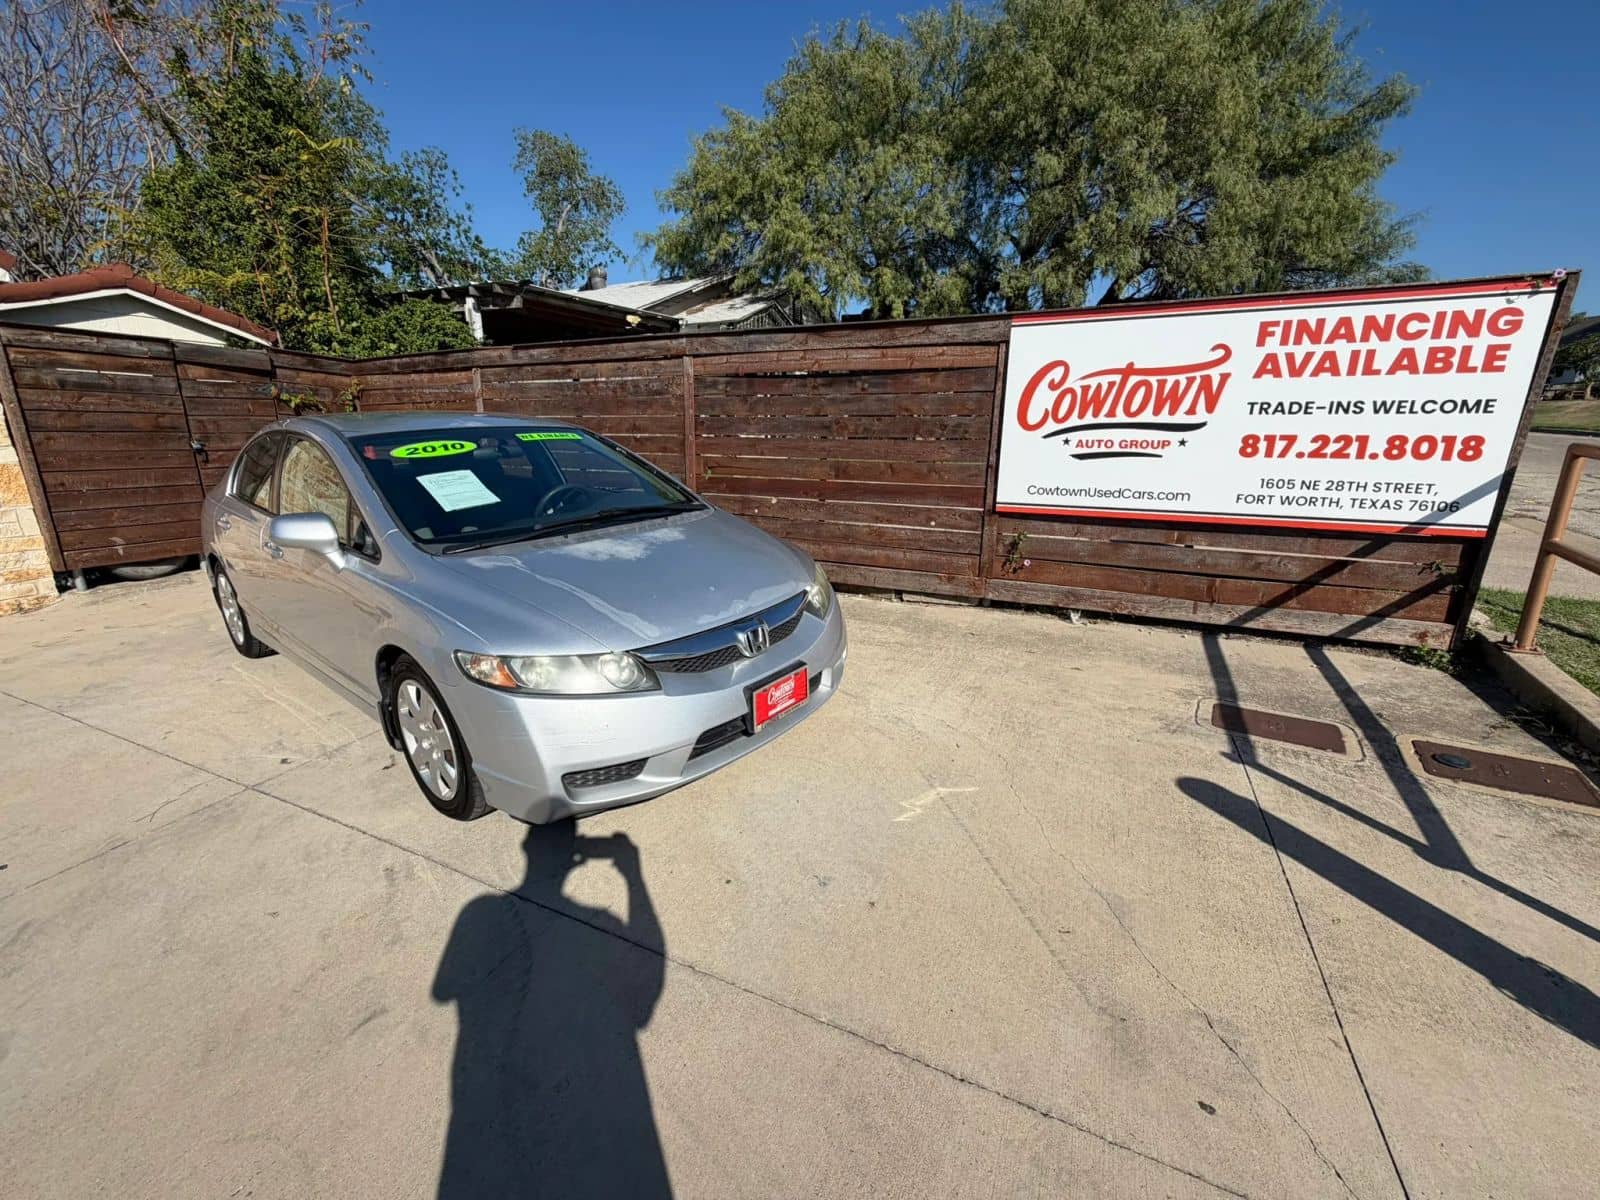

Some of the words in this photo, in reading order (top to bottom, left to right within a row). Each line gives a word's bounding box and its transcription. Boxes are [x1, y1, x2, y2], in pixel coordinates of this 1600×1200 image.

[1256, 307, 1525, 347] FINANCING
[1252, 344, 1512, 379] AVAILABLE
[1247, 400, 1365, 415] TRADE-INS
[1372, 399, 1497, 414] WELCOME
[405, 442, 465, 456] 2010
[1075, 439, 1114, 449] AUTO
[1118, 439, 1171, 450] GROUP
[1238, 433, 1486, 462] 817.221.8018
[1027, 484, 1191, 502] CowtownUsedCars.com
[1259, 478, 1296, 490] 1605
[1300, 479, 1321, 491] NE
[1325, 480, 1368, 493] 28TH
[1372, 482, 1438, 497] STREET,
[1235, 493, 1276, 505] FORT
[1280, 495, 1344, 510] WORTH,
[1350, 497, 1403, 511] TEXAS
[1409, 499, 1460, 513] 76106
